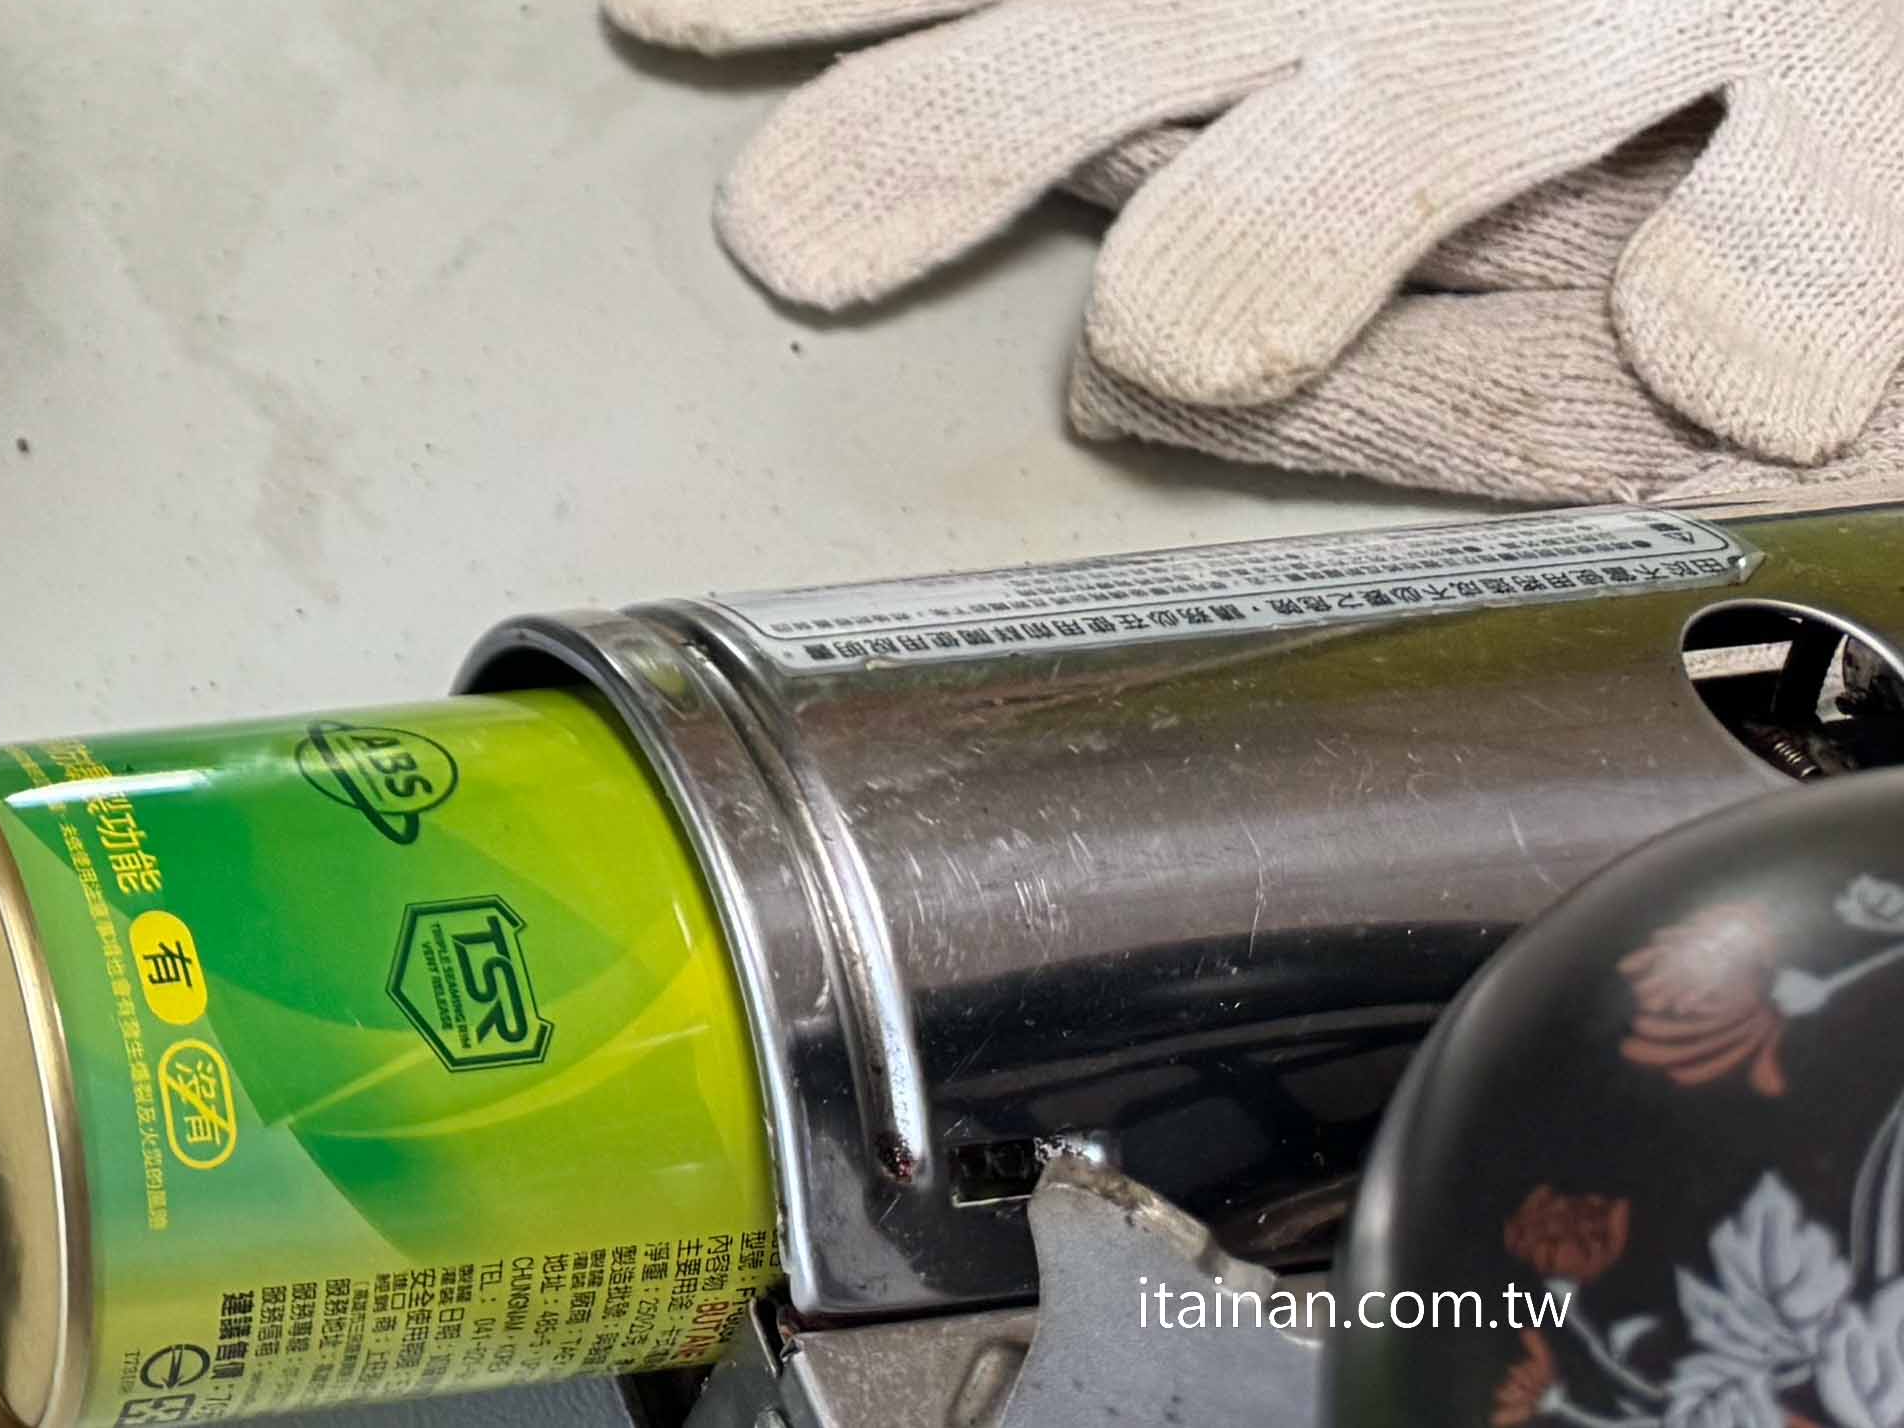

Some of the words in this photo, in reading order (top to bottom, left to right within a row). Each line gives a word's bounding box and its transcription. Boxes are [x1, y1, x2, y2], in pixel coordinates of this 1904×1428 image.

[352, 735, 433, 799] ABS
[143, 940, 193, 988] 有
[451, 915, 528, 1044] TSR
